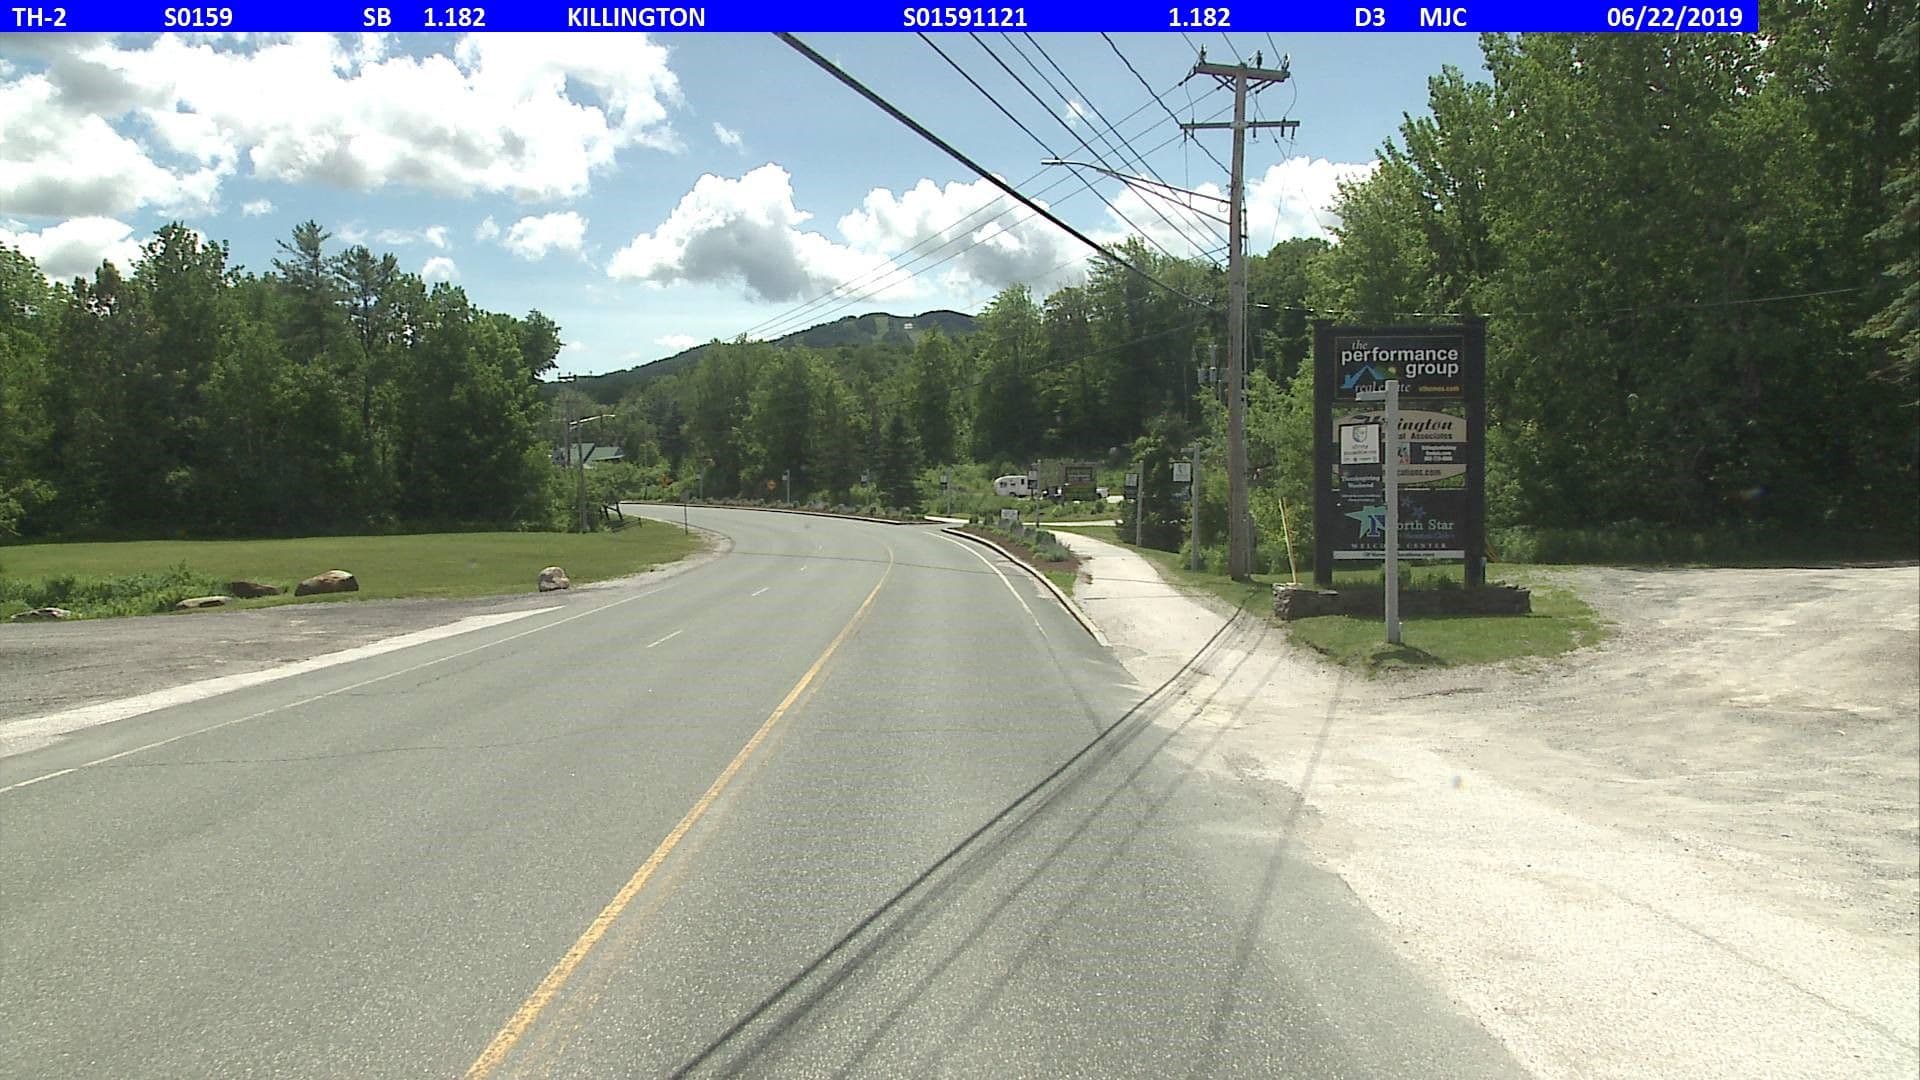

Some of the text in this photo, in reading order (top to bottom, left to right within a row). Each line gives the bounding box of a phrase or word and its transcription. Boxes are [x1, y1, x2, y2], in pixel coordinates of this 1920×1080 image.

[1352, 340, 1368, 350] the
[1341, 347, 1458, 366] performance
[1405, 363, 1459, 378] group
[1428, 519, 1454, 531] Star
